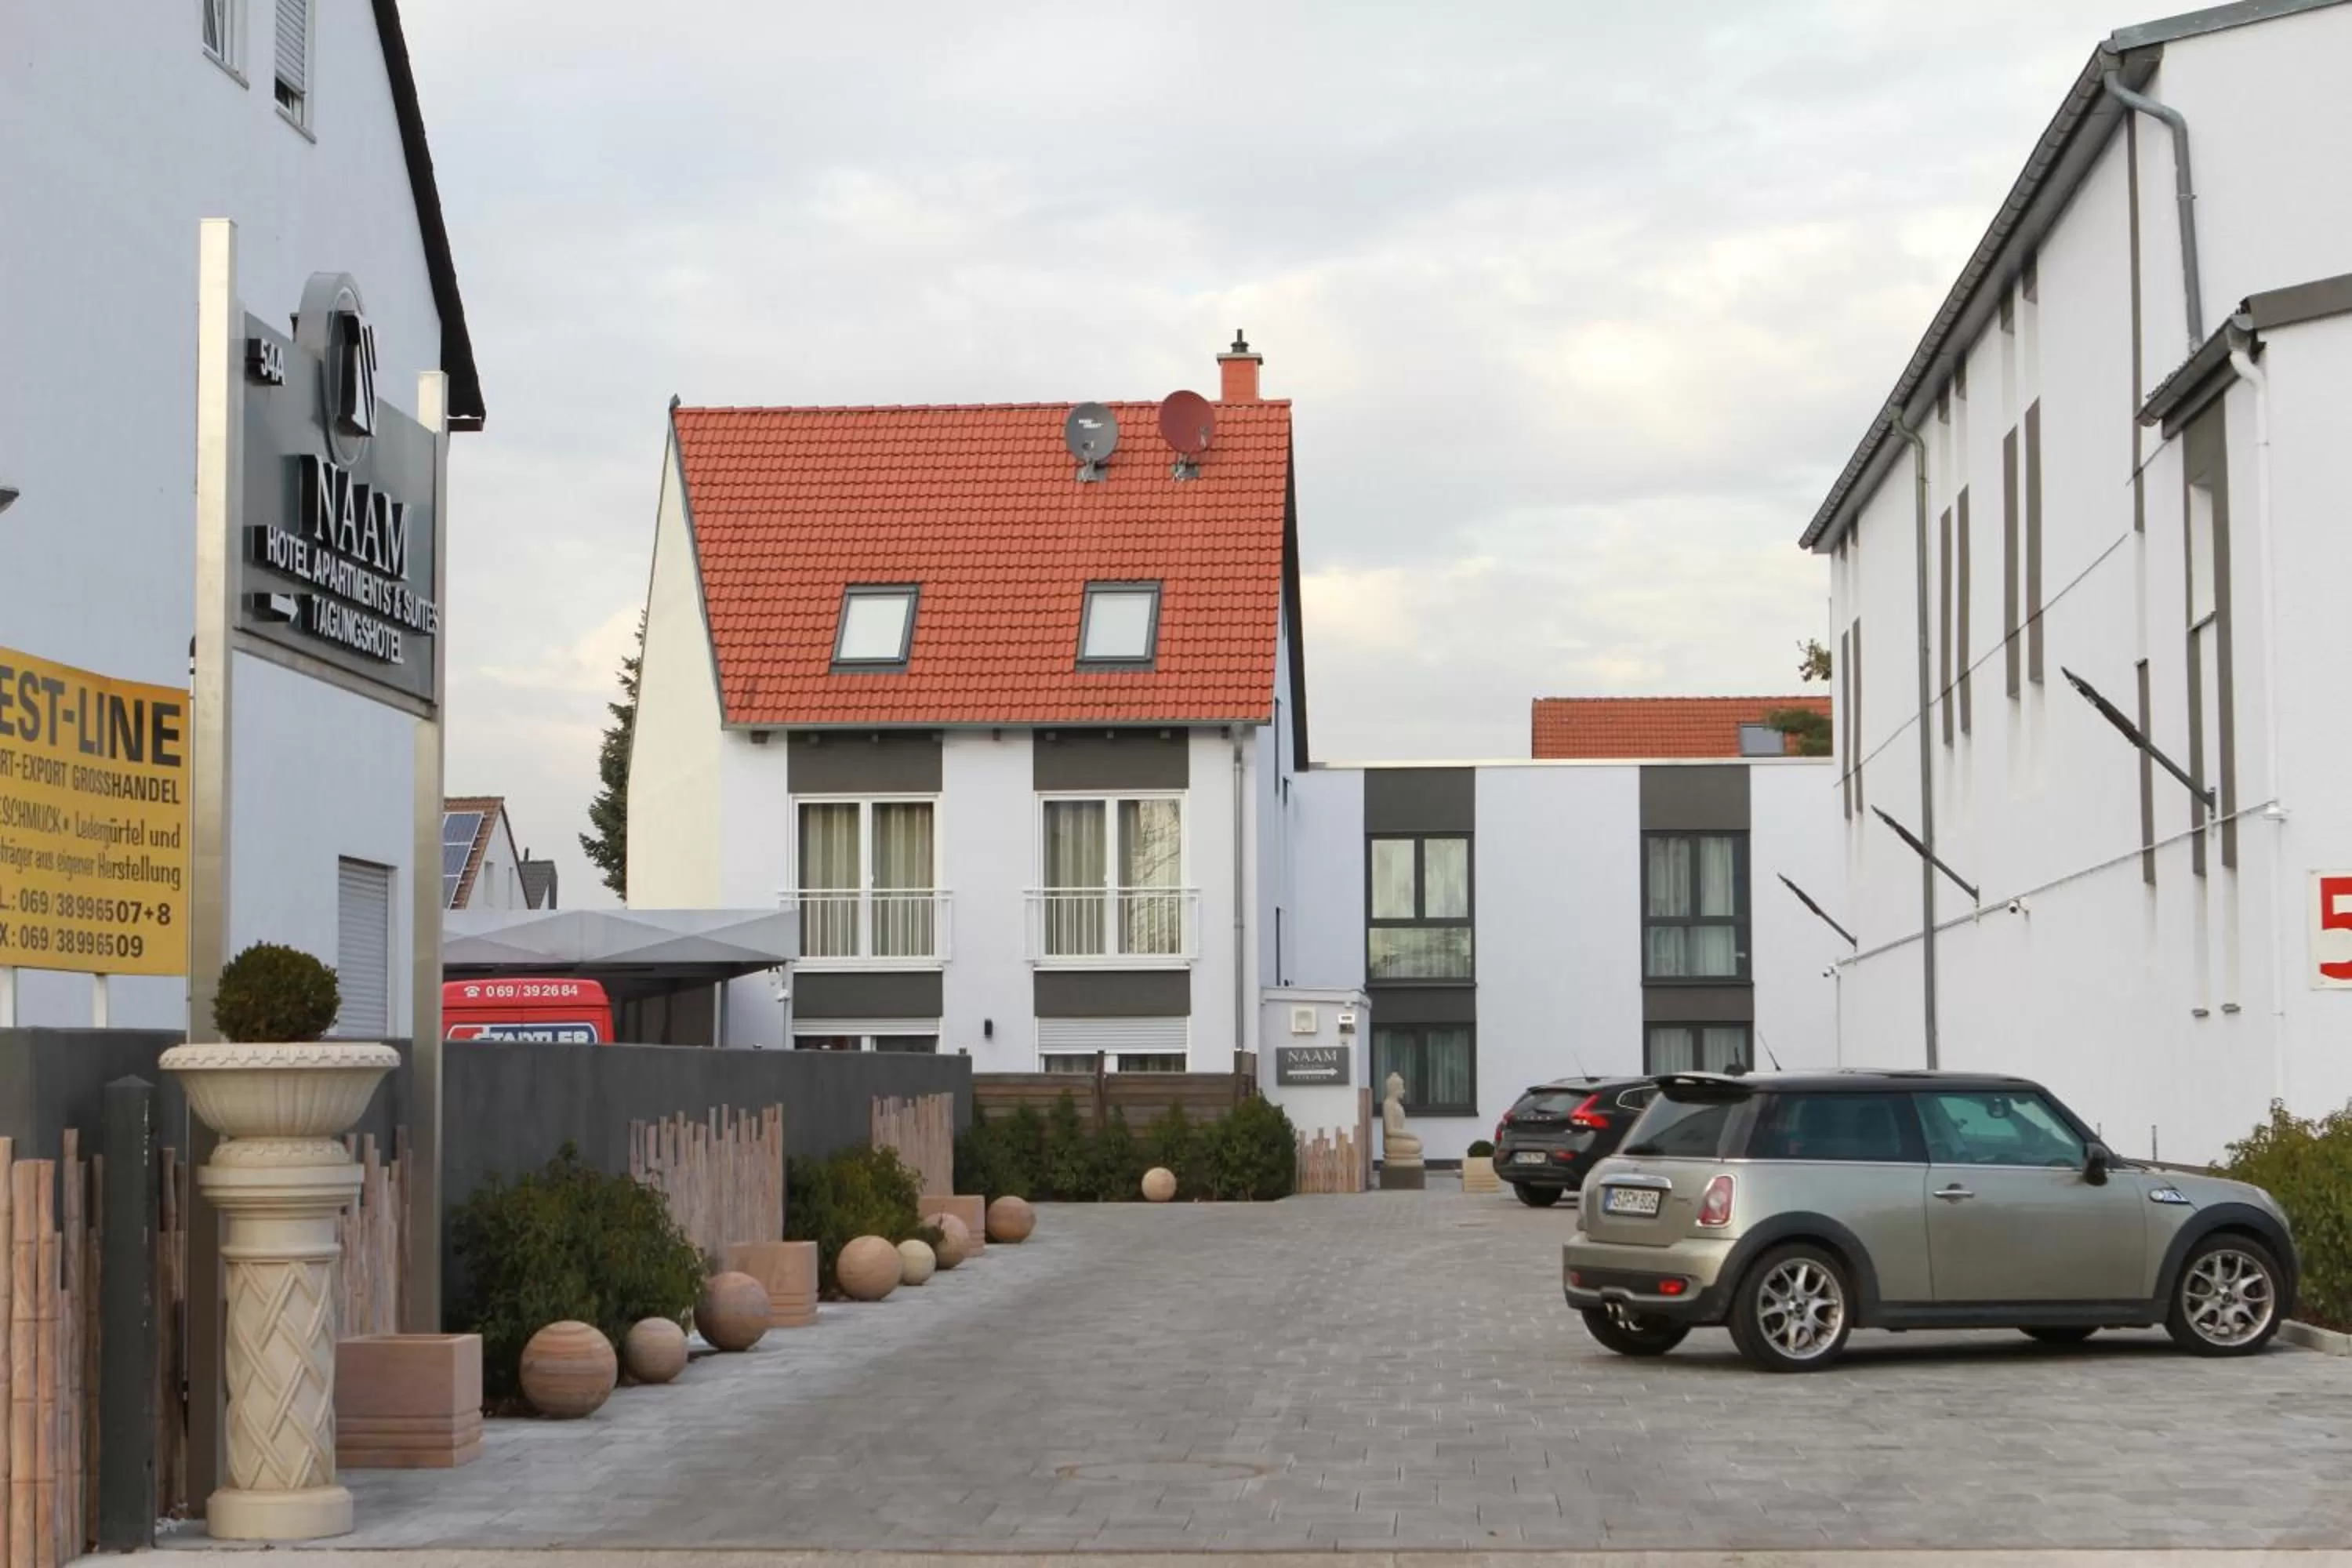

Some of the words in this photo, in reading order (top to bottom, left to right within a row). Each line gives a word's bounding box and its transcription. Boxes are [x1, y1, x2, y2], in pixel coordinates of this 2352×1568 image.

[261, 339, 286, 386] 54A
[314, 452, 412, 582] NAAM
[267, 523, 312, 580] HOTEL
[314, 548, 391, 615] APARTMENTS
[391, 583, 402, 620] &
[403, 588, 439, 634] SUITES
[311, 593, 405, 665] TAGUNGSHOTEL
[72, 764, 181, 804] GROSSHANDEL
[0, 794, 62, 835] SCHMUCK
[150, 822, 181, 849] und
[97, 852, 181, 891] Herstellung
[1288, 1050, 1338, 1063] NAAM
